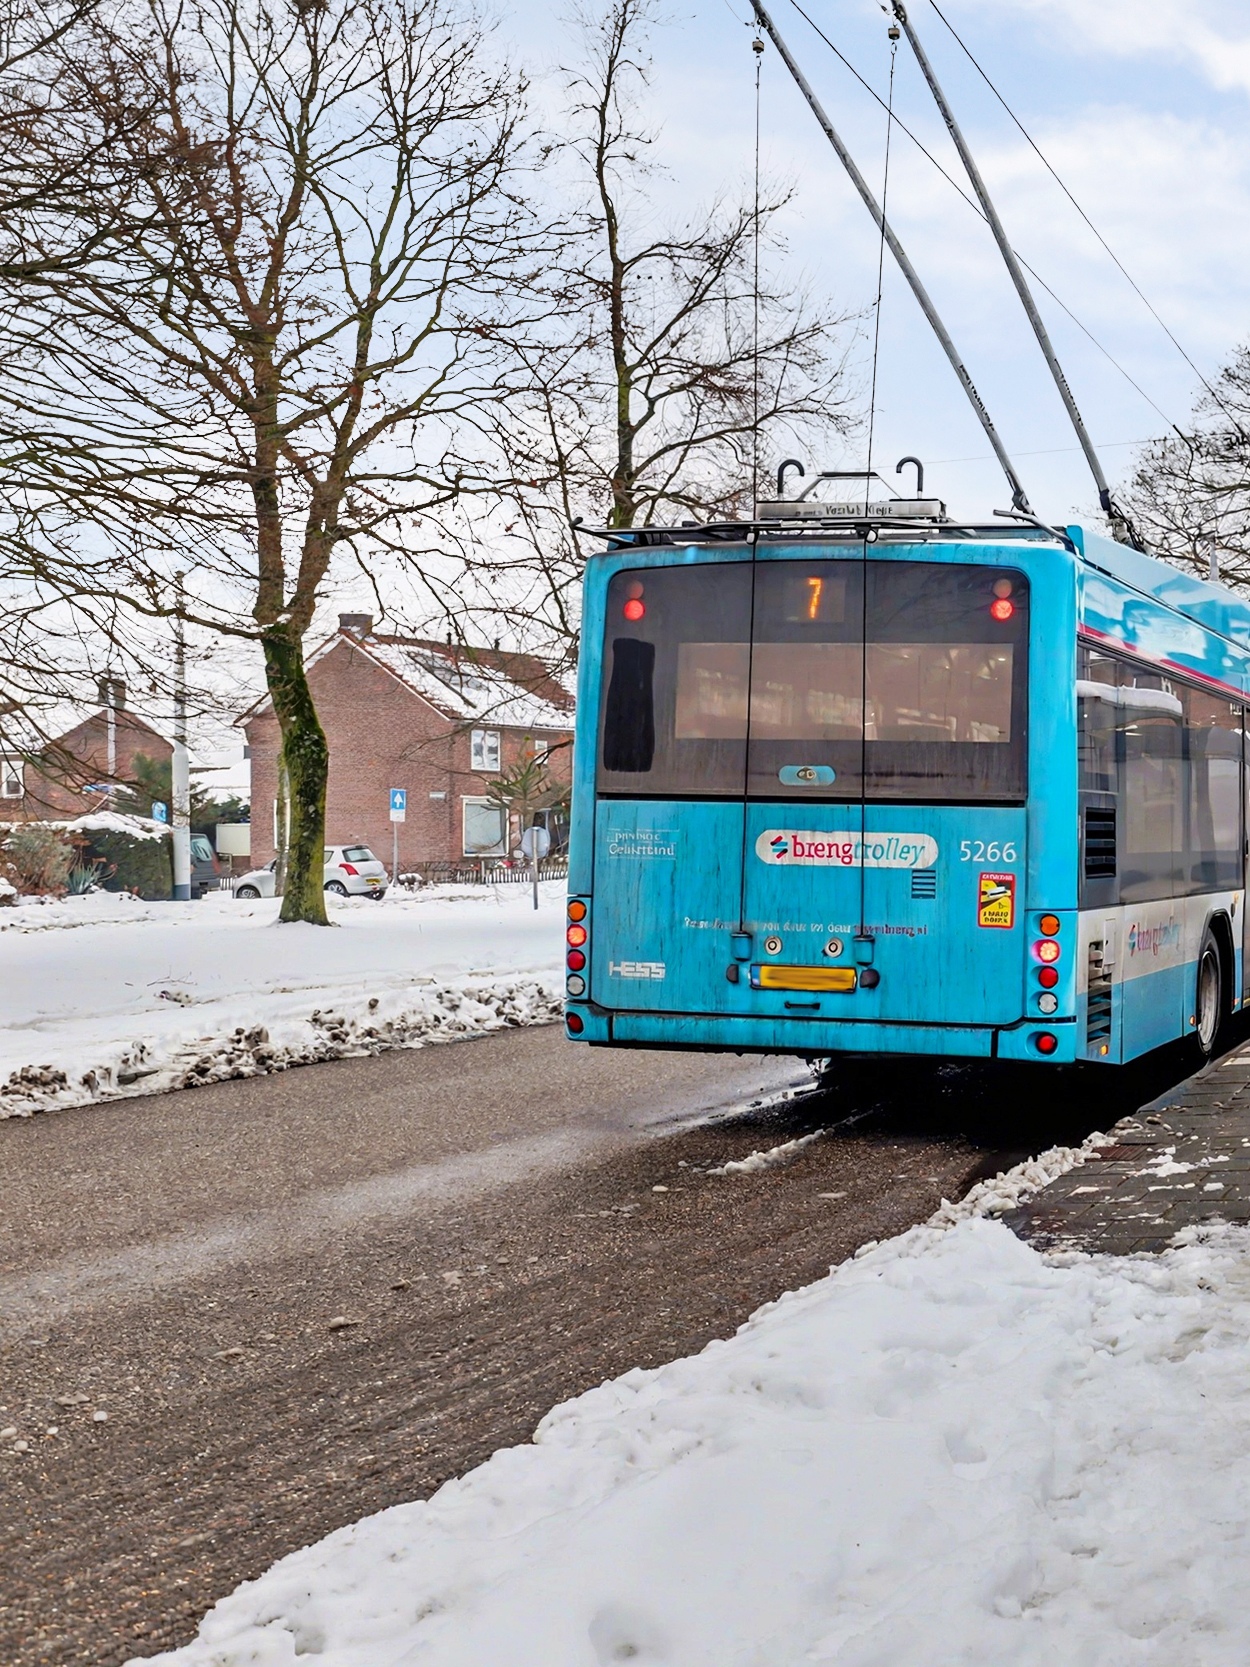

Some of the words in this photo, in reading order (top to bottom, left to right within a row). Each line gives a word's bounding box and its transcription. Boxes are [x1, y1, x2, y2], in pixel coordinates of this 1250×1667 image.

[808, 578, 822, 618] 7
[791, 834, 926, 867] brengtrolley
[960, 840, 1017, 863] 5266
[608, 961, 666, 978] HESS
